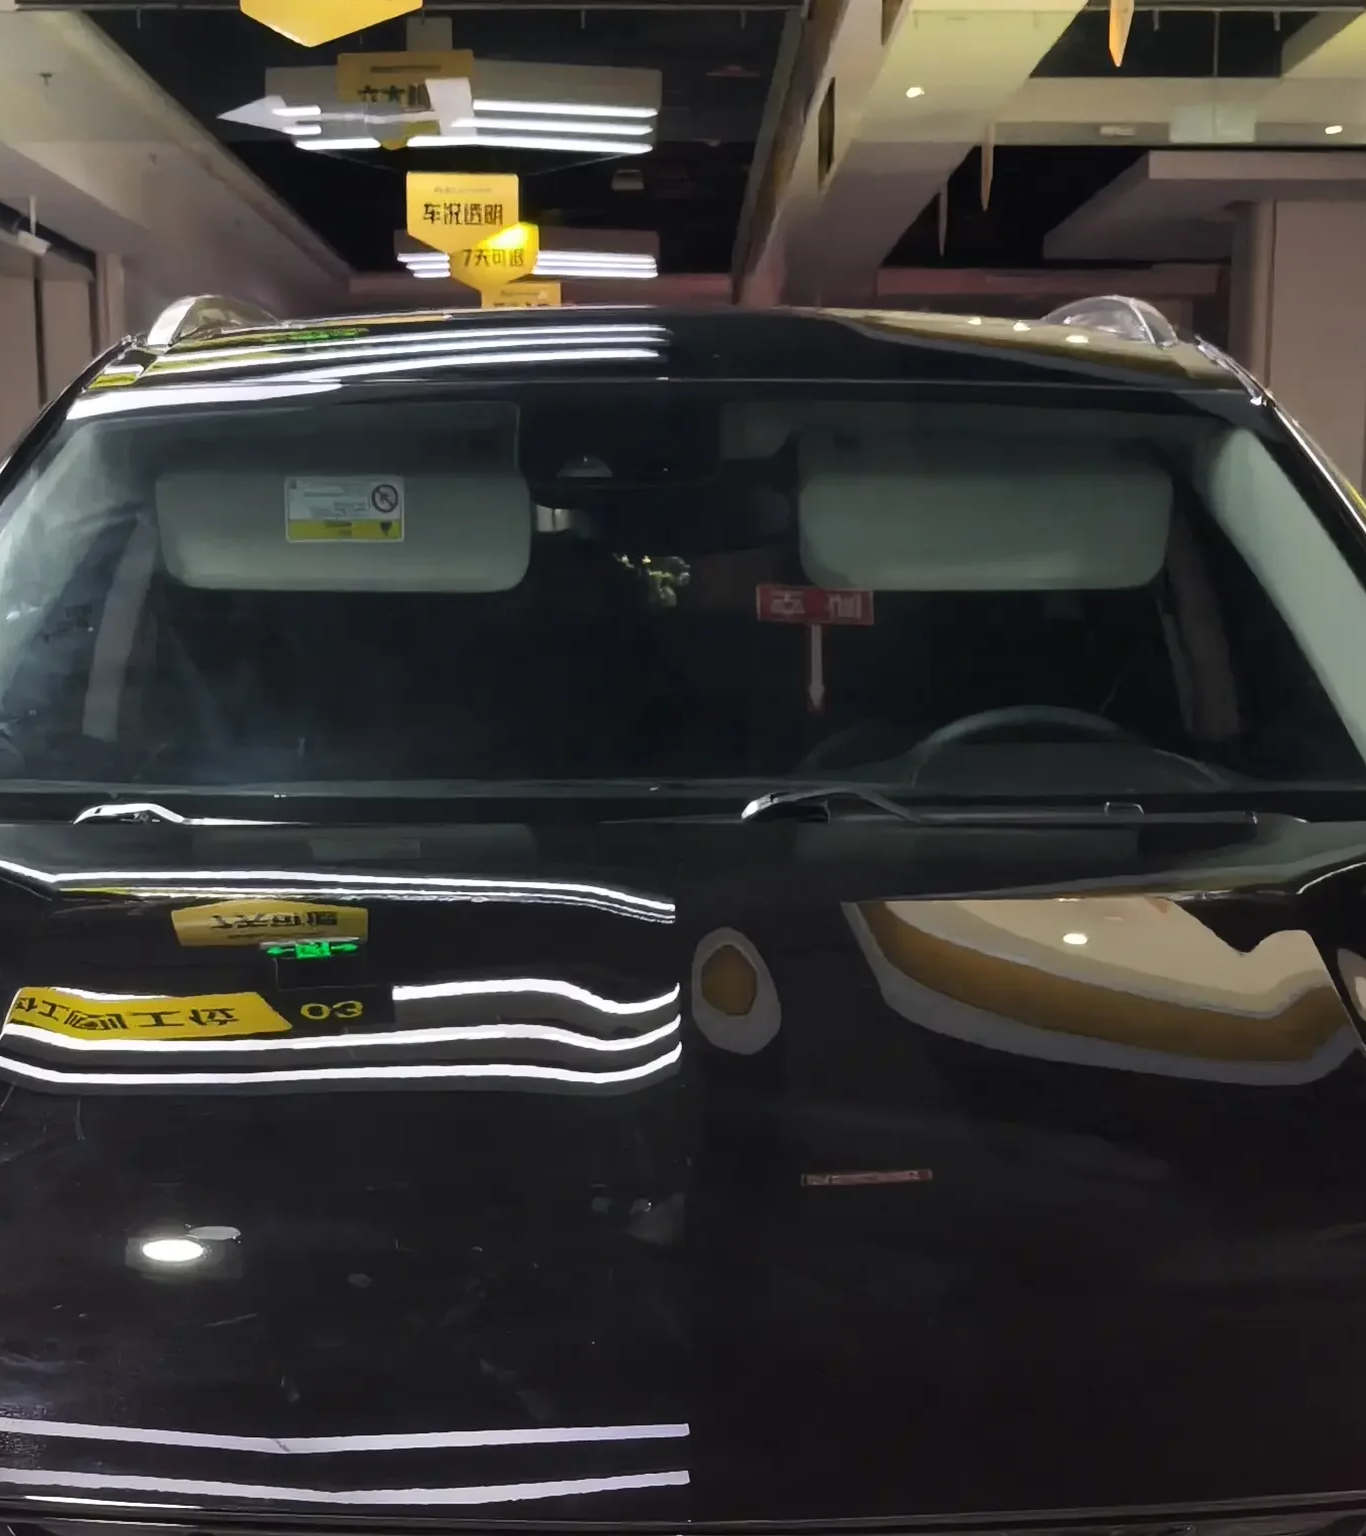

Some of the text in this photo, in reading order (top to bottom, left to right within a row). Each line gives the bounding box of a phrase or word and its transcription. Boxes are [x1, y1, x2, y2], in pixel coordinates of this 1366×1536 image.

[423, 202, 504, 226] 车况透明
[462, 248, 524, 268] 7天可退
